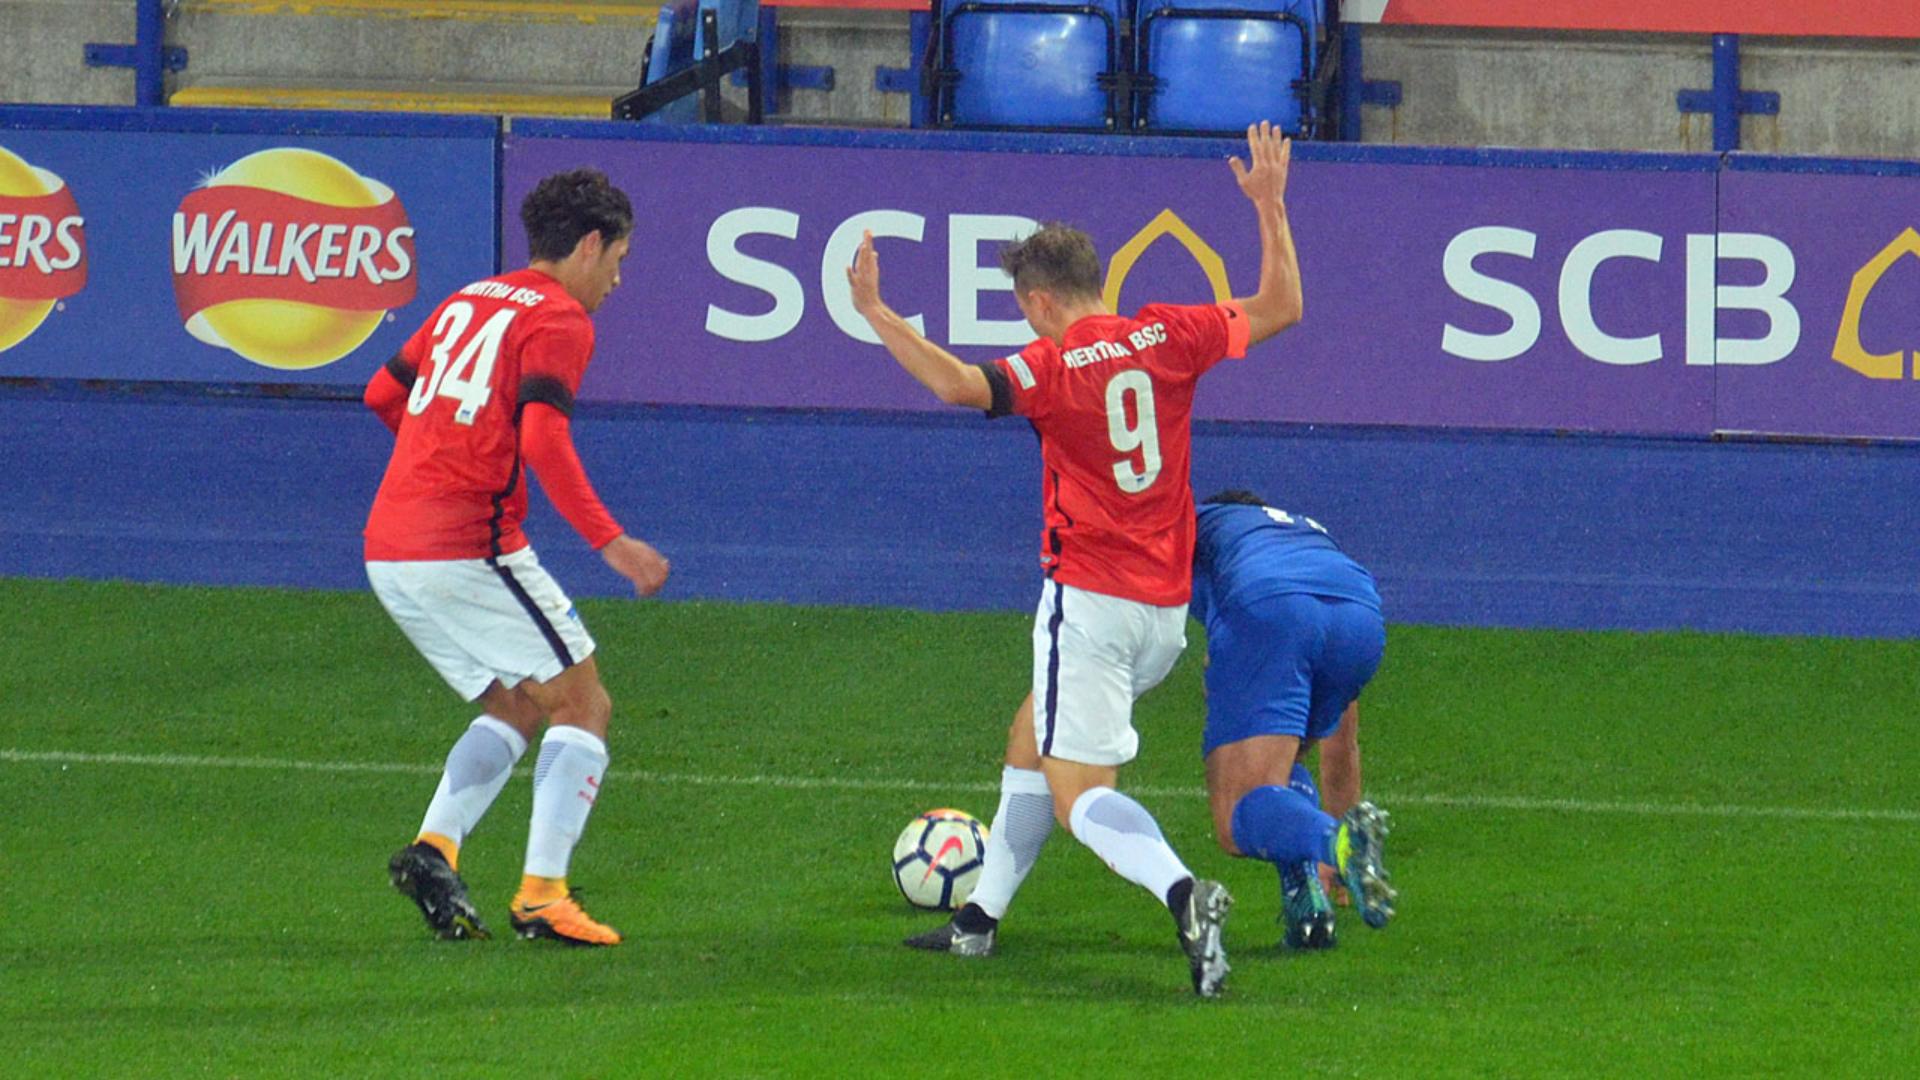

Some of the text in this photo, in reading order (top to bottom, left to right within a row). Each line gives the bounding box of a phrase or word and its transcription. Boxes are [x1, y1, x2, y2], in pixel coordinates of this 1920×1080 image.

[172, 210, 416, 284] WALKERS
[704, 206, 1043, 346] SCB
[1441, 225, 1801, 365] SCB
[407, 301, 518, 426] 34
[1128, 322, 1168, 351] BSC
[1105, 369, 1162, 493] 9
